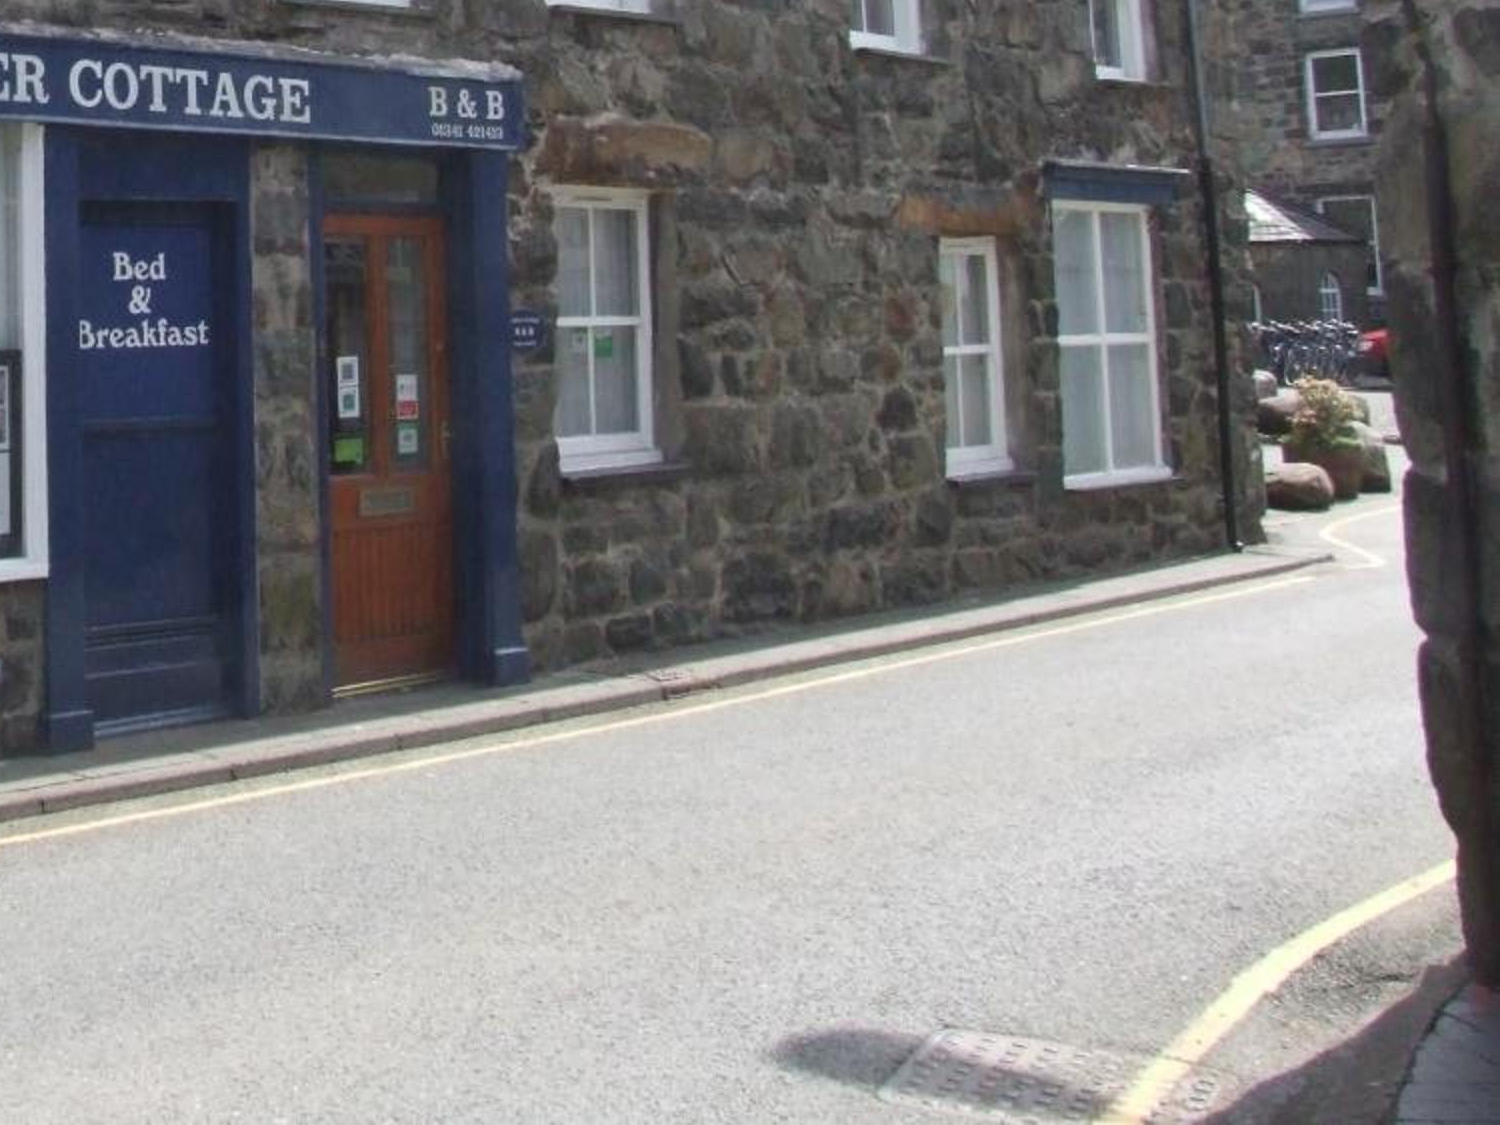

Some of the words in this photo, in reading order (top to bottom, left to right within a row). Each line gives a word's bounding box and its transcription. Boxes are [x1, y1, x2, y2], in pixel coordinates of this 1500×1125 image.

[69, 58, 312, 124] COTTAGE
[428, 86, 448, 117] B
[457, 90, 478, 120] &
[486, 91, 505, 121] B
[112, 251, 167, 281] Bed
[128, 285, 152, 315] &
[78, 317, 210, 350] Breakfast
